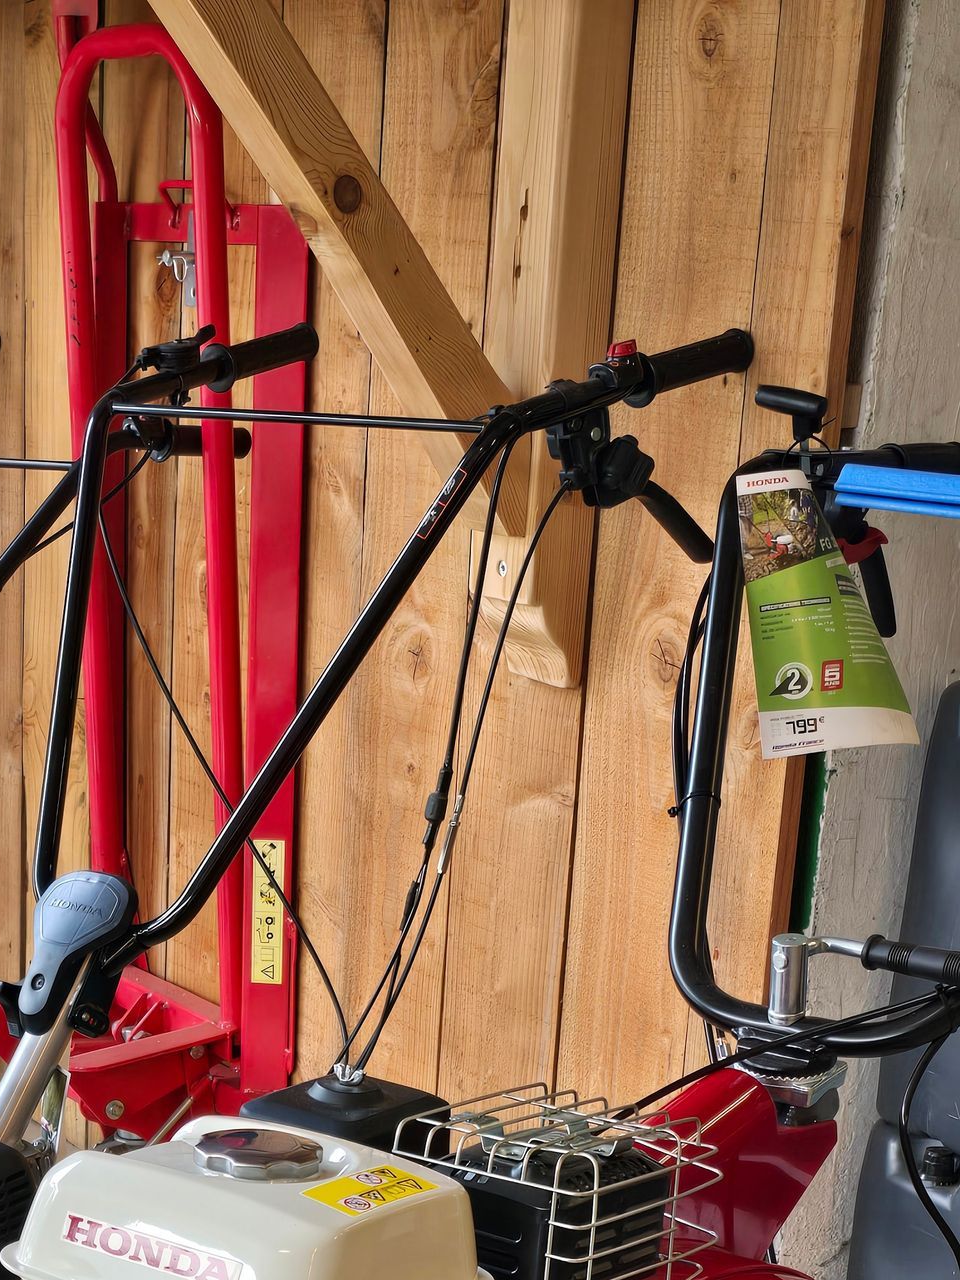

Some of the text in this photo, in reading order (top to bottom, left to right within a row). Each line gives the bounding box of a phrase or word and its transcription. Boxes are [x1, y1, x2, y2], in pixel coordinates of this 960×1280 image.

[746, 476, 789, 488] HONDA
[786, 668, 802, 691] 2
[824, 667, 840, 682] 5
